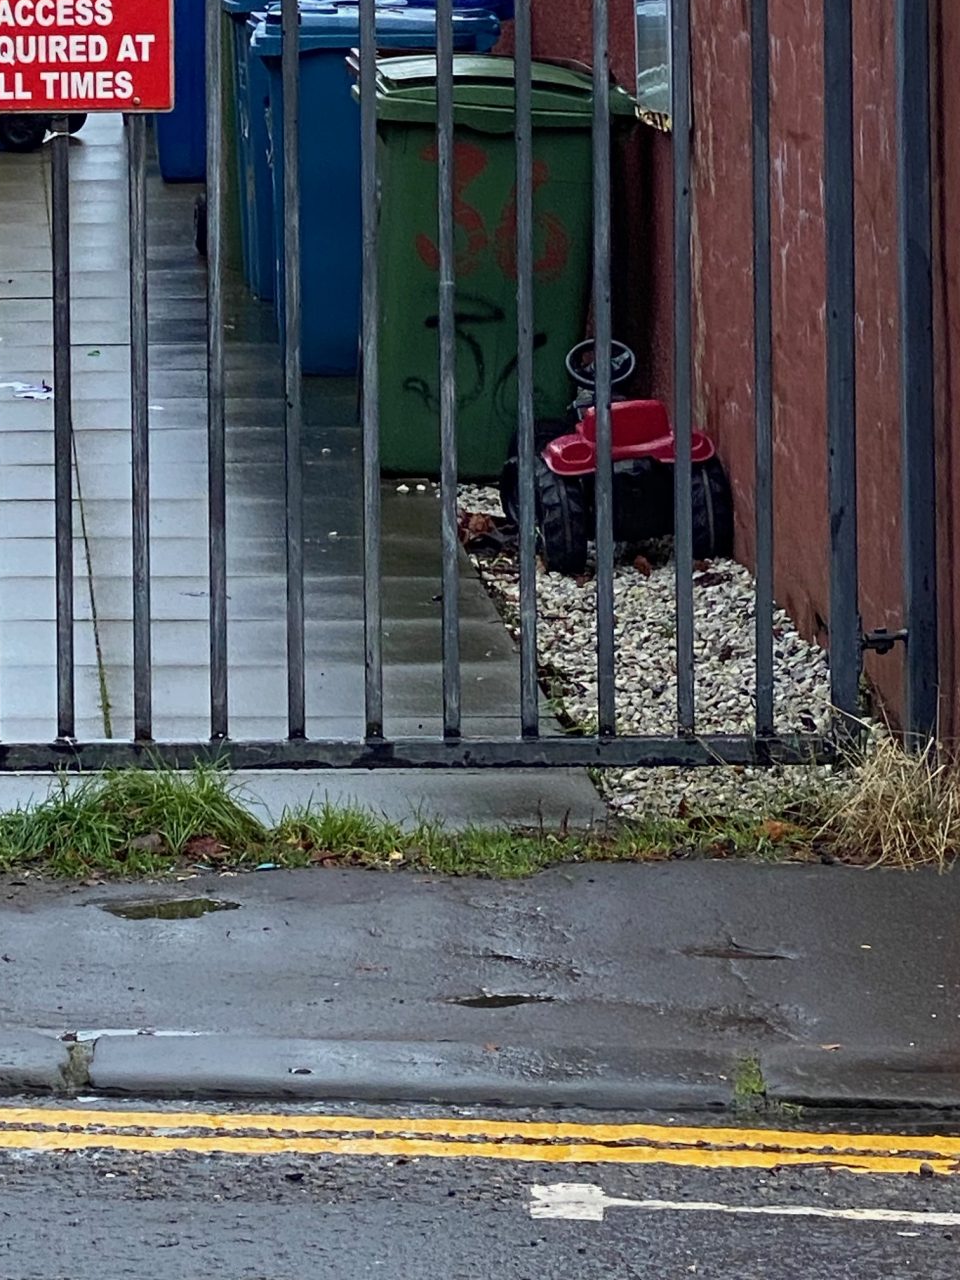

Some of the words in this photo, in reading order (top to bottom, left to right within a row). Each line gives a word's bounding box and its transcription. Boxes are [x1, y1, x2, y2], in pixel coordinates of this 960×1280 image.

[116, 34, 155, 62] AT
[40, 70, 134, 99] TIMES
[414, 140, 570, 284] 36
